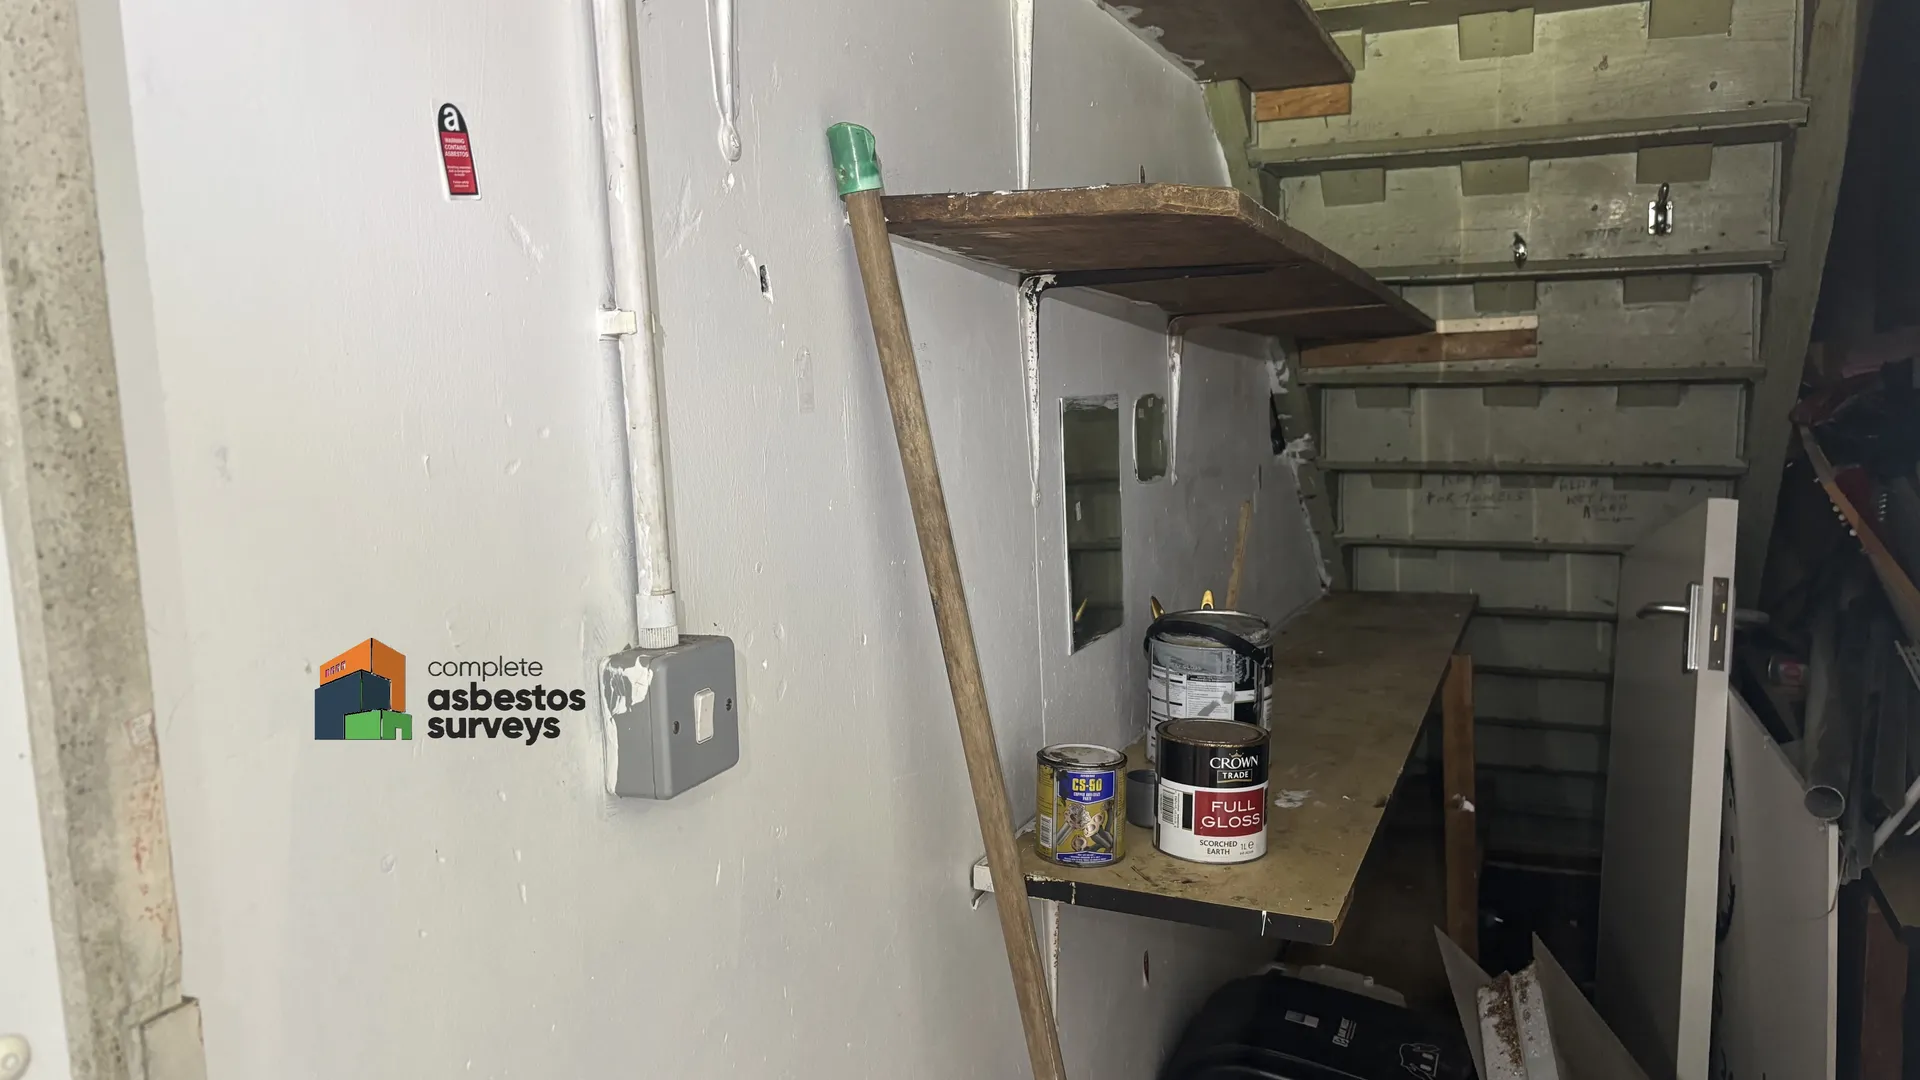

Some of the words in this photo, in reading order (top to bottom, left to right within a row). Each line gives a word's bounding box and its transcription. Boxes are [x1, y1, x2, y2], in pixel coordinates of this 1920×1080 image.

[443, 107, 460, 131] a
[1209, 755, 1259, 770] CROWN
[1222, 771, 1249, 779] TRADE
[1211, 800, 1256, 813] FULL
[1201, 813, 1260, 829] GLOSS
[1199, 840, 1238, 848] SCORCHED
